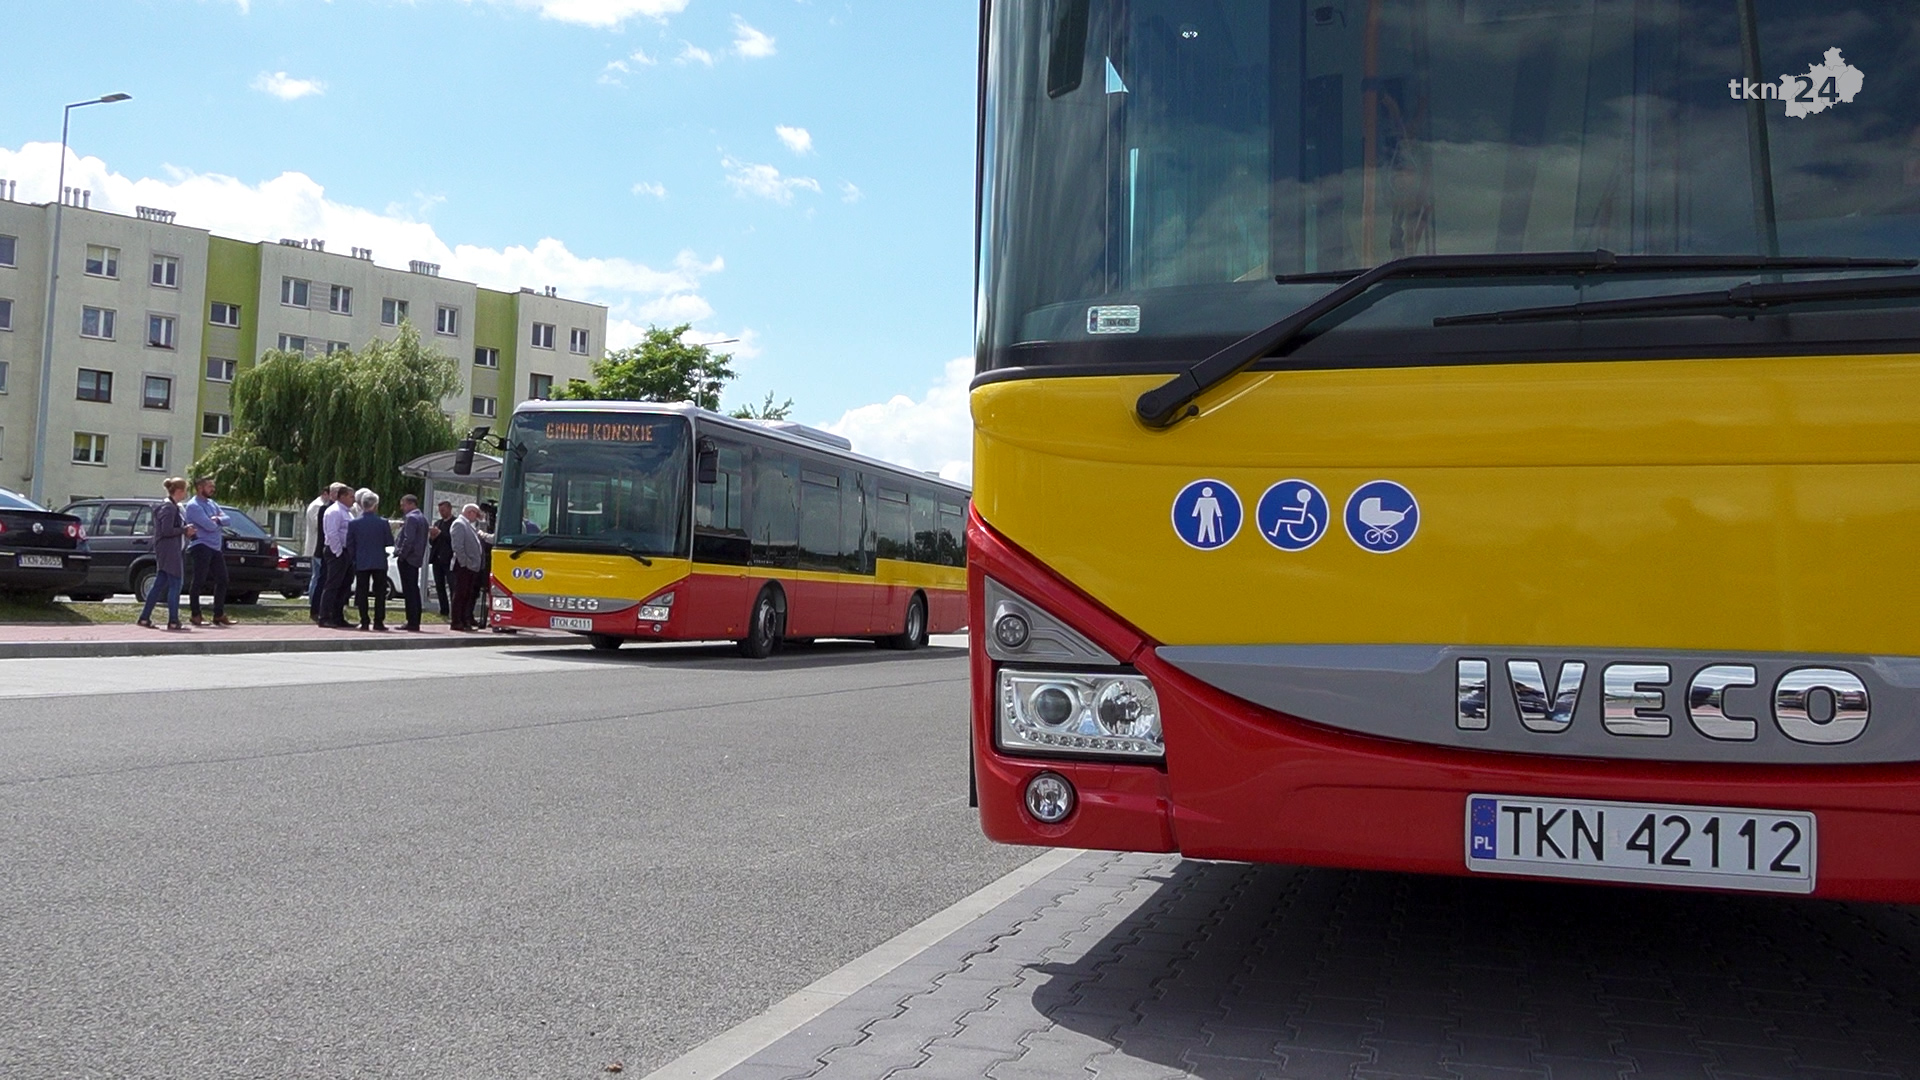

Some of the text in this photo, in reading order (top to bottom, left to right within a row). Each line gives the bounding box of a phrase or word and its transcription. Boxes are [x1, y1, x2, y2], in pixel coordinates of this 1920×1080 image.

[549, 597, 599, 610] IVECO
[556, 618, 569, 628] TKN
[1455, 656, 1870, 746] IVECO
[1474, 836, 1493, 851] PL
[1501, 806, 1802, 873] TKN 42112
